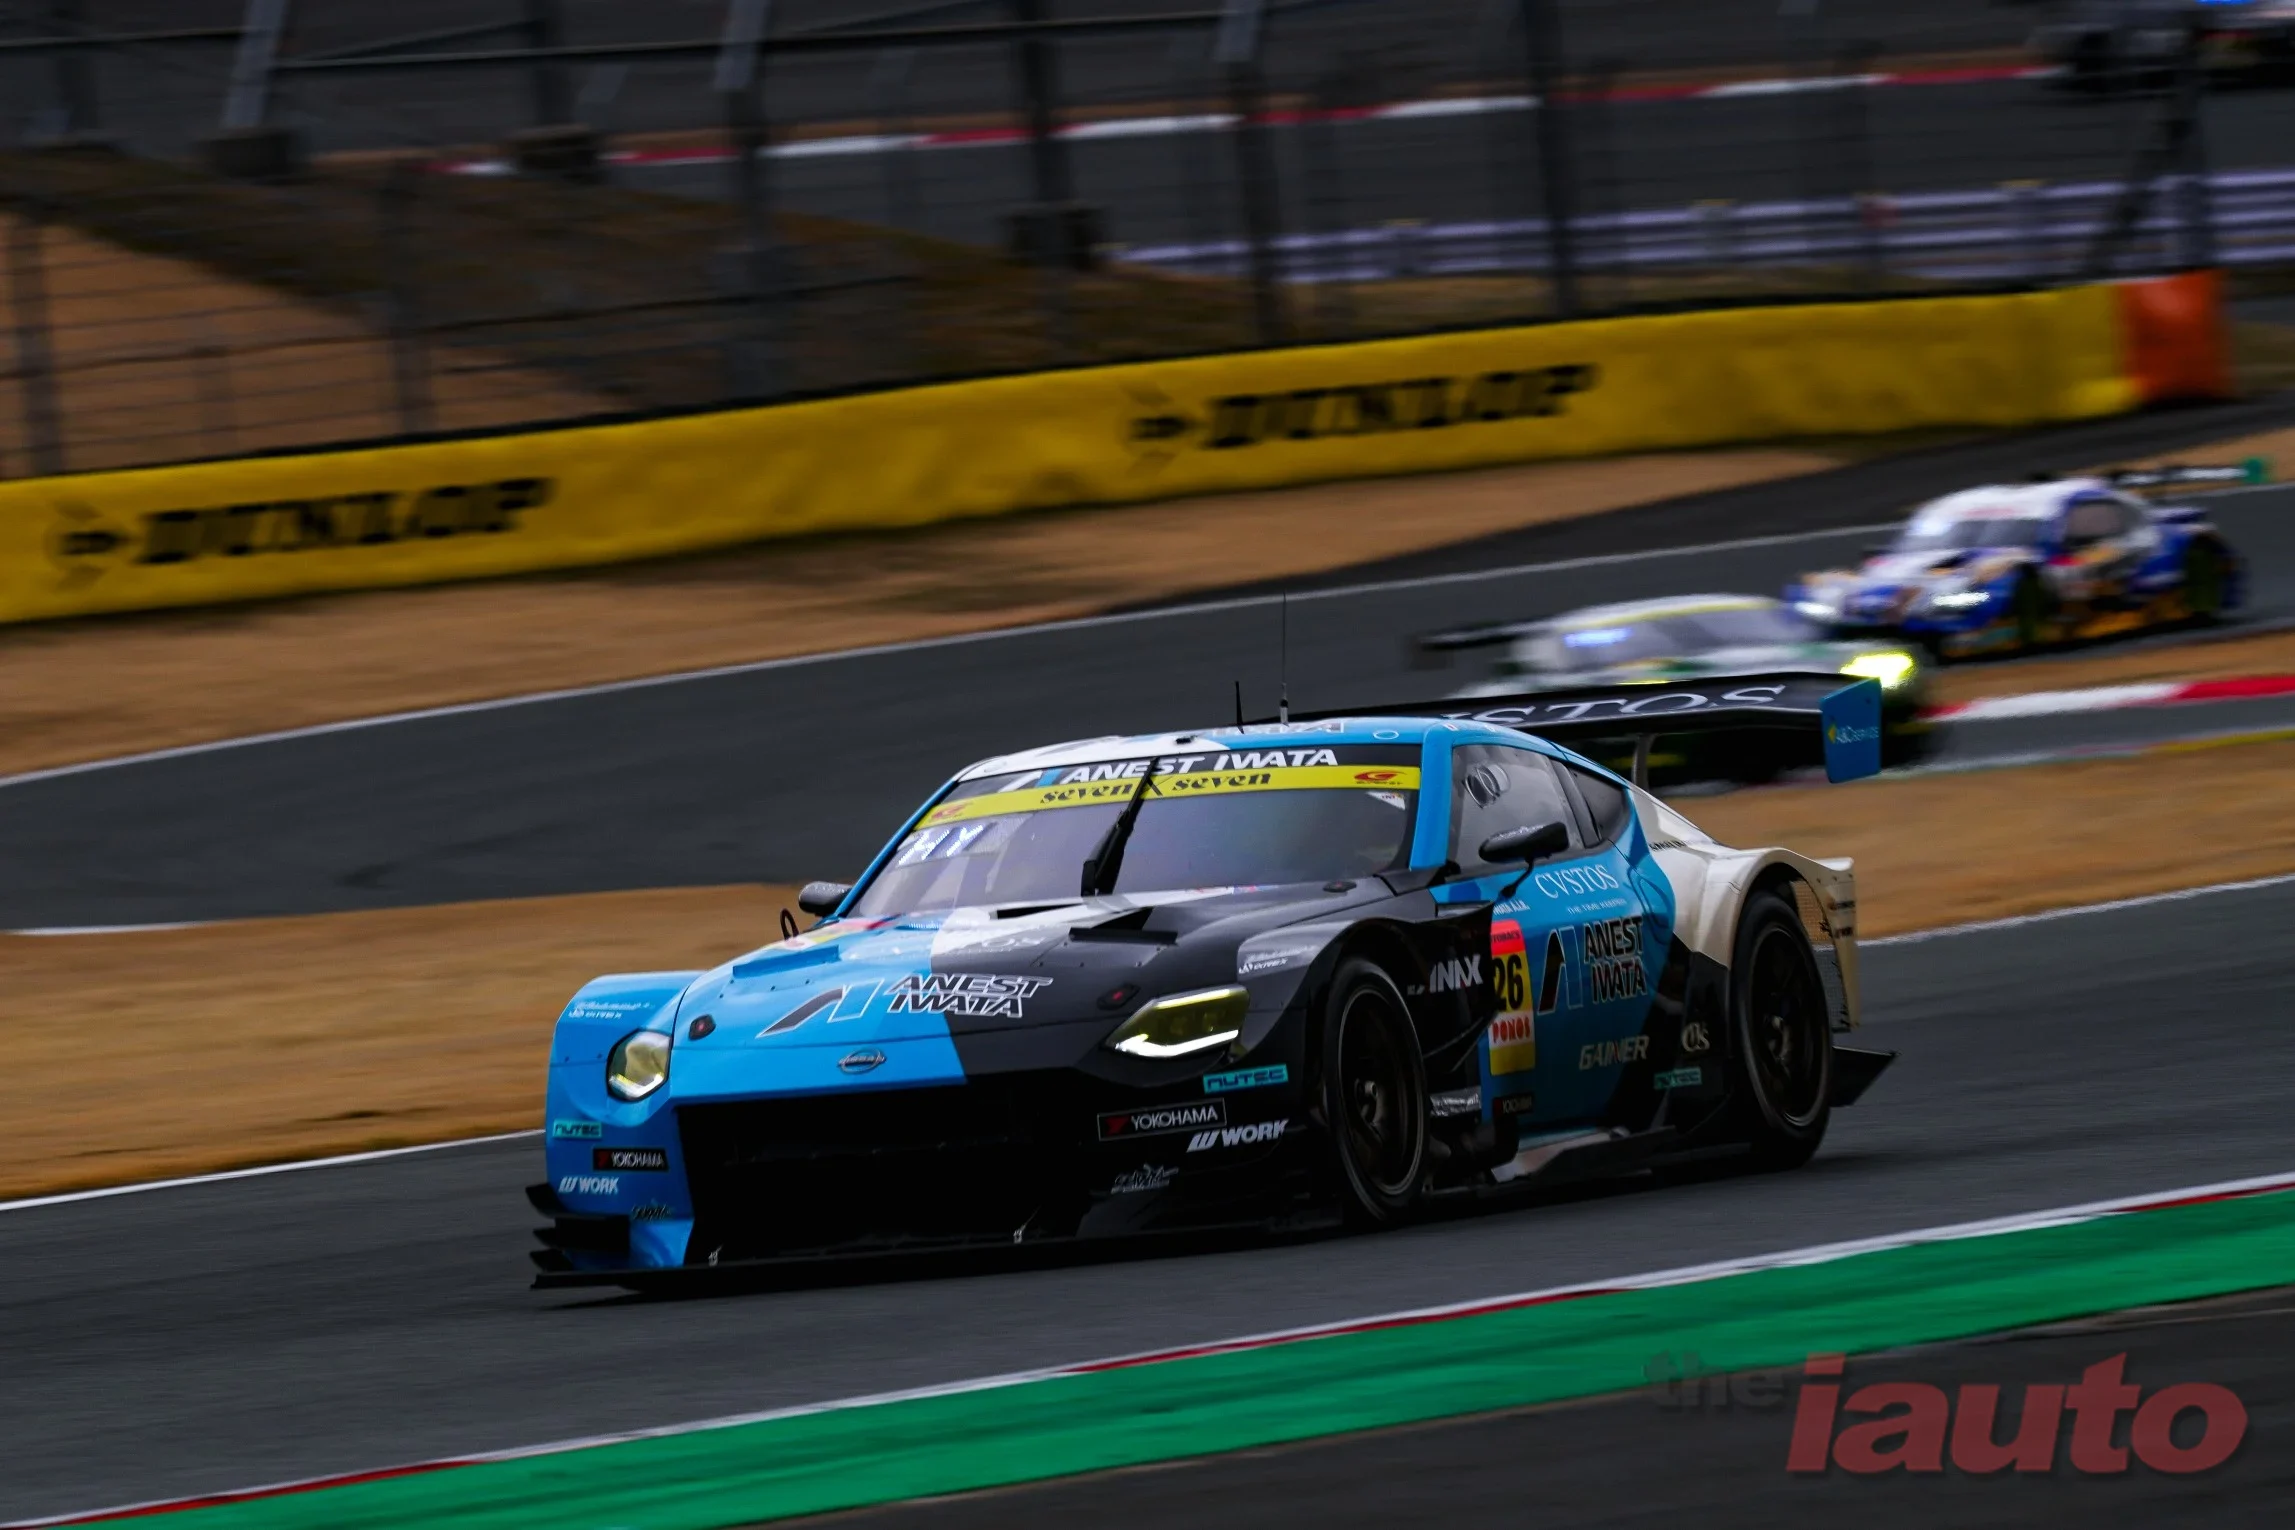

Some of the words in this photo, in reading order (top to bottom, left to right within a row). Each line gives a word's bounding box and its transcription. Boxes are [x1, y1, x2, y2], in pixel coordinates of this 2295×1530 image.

[1200, 363, 1602, 449] DUNLOP
[133, 476, 554, 565] DUNLOP
[1440, 684, 1786, 724] STOS
[1059, 756, 1205, 784] ANEST
[1213, 749, 1338, 771] IWATA
[1040, 783, 1134, 804] seven
[1172, 773, 1272, 791] seven
[1535, 864, 1620, 899] CVSTOS
[1583, 915, 1644, 964] ANEST
[883, 973, 1054, 998] ANEST
[1493, 954, 1524, 1011] 26
[1591, 956, 1648, 1005] IWATA
[887, 993, 1024, 1018] IWATA
[1492, 1017, 1530, 1043] PONOS
[1579, 1036, 1650, 1070] GAINER
[1206, 1068, 1287, 1092] NUTEC
[1130, 1105, 1219, 1132] YOKOHAMA
[1221, 1118, 1290, 1148] WORK
[610, 1150, 666, 1168] YOKOHAMA
[578, 1177, 620, 1195] WORK
